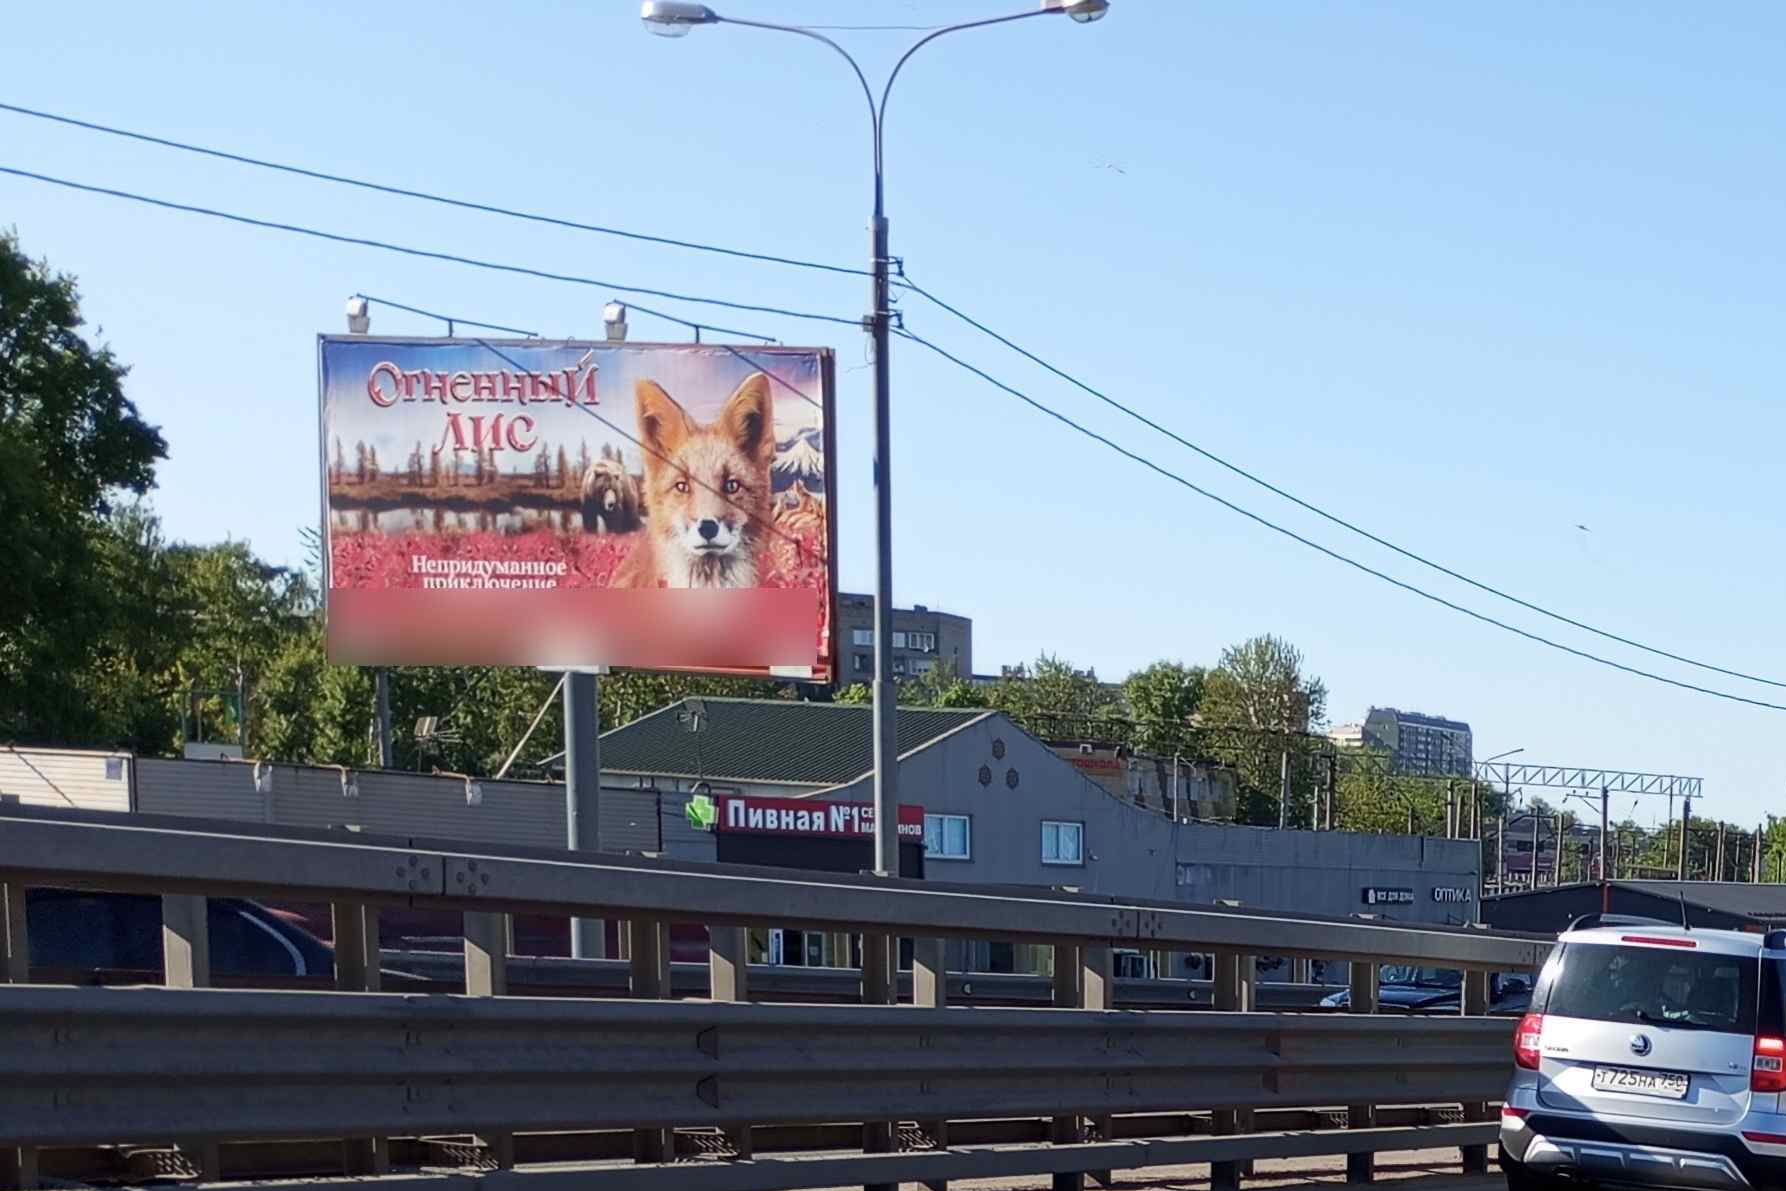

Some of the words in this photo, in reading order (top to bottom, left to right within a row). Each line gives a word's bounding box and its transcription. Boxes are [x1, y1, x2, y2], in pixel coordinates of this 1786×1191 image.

[412, 555, 568, 579] Непридуманное
[728, 800, 825, 832] Пивная
[1434, 887, 1472, 902] ОПТИКА
